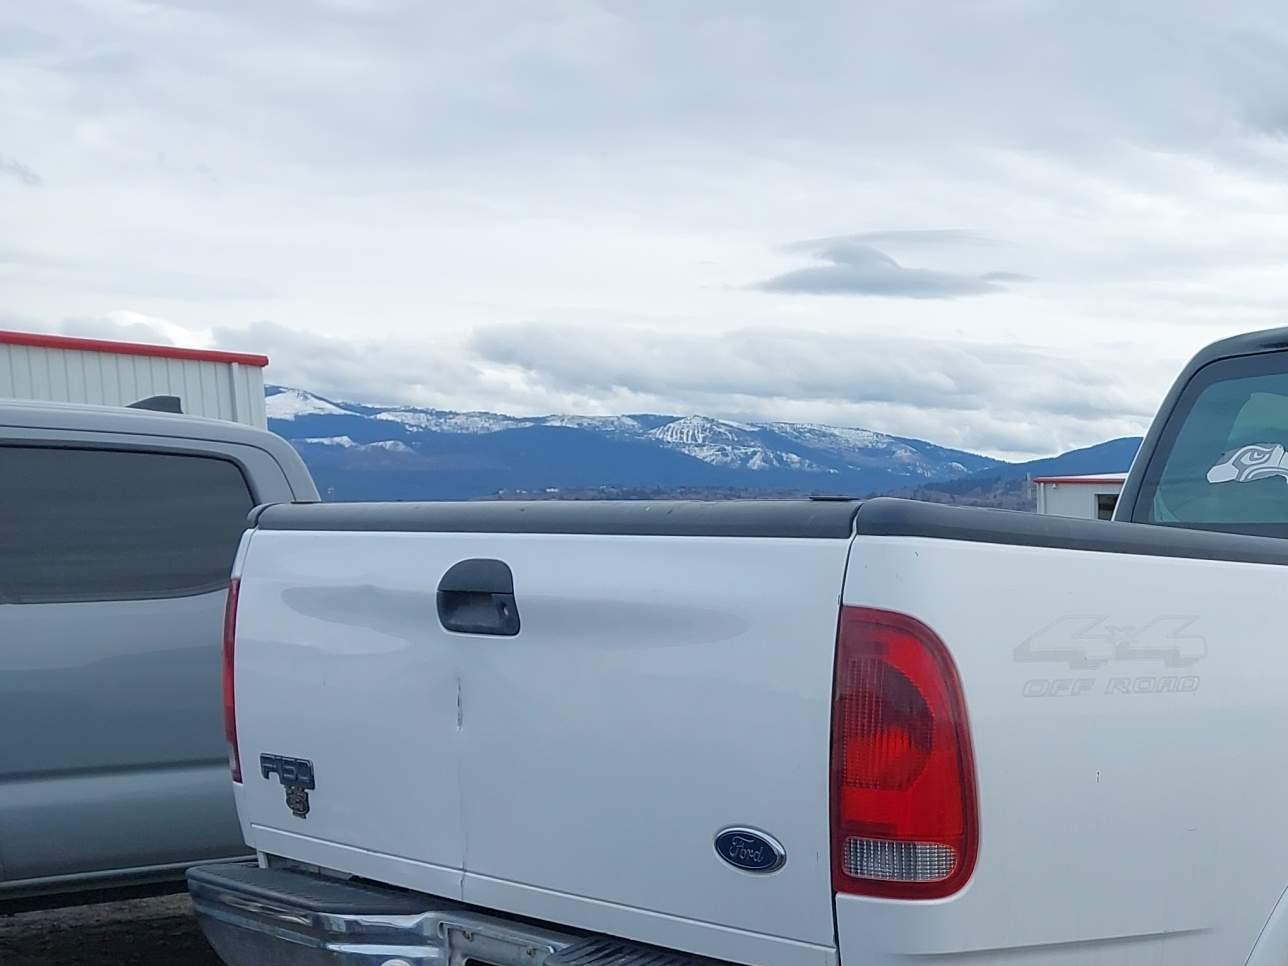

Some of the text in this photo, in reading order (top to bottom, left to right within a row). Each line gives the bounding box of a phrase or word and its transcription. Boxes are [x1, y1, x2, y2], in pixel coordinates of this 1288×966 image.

[1022, 675, 1200, 698] OFF ROAD
[259, 752, 315, 790] F150
[728, 835, 765, 863] Ford
